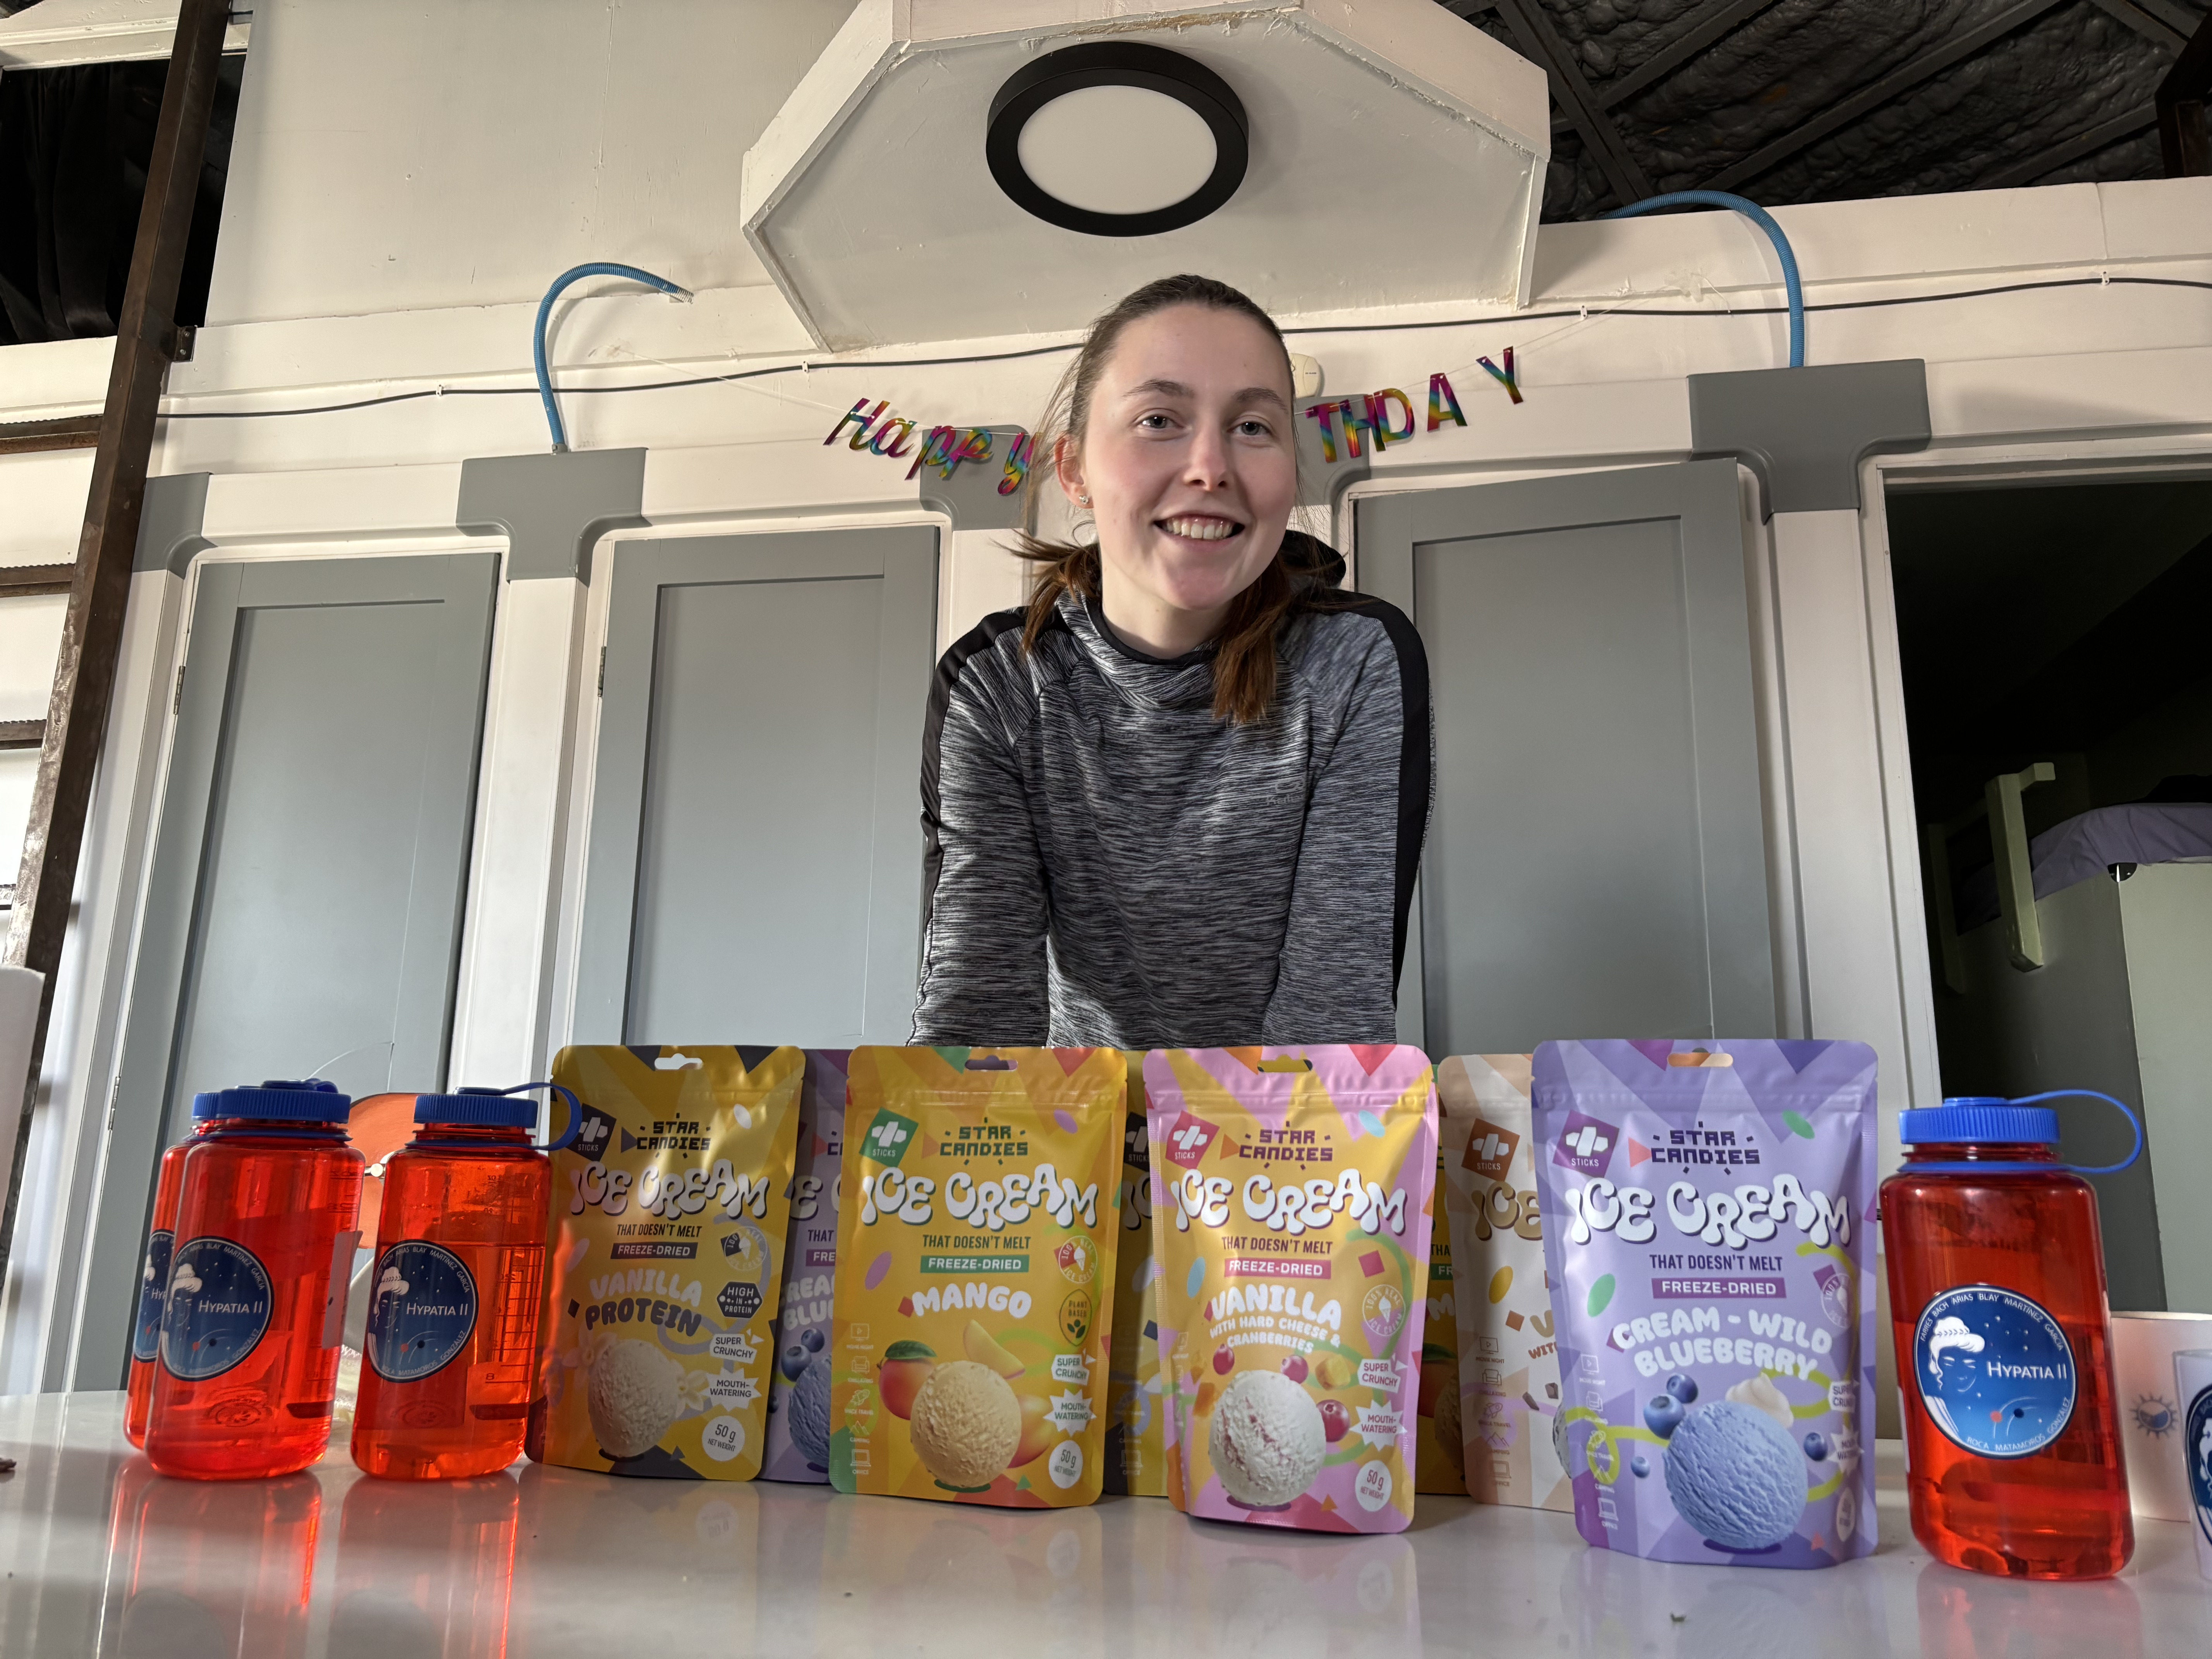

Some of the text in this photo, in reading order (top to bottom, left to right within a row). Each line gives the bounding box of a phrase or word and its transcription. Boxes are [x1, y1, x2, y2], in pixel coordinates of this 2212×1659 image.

[653, 1121, 699, 1134] STAR
[959, 1126, 1012, 1140] STAR
[637, 1137, 711, 1150] CANDIES
[1259, 1129, 1316, 1144] STAR
[1670, 1130, 1736, 1146] STAR
[872, 1148, 896, 1158] STICKS
[940, 1142, 1028, 1156] CANDIES
[1175, 1151, 1195, 1160] STICKS
[1239, 1145, 1333, 1161] CANDIES
[1651, 1147, 1760, 1164] CANDIES
[1477, 1162, 1501, 1171] STICKS
[1571, 1157, 1600, 1167] STICKS
[570, 1161, 632, 1216] ICE
[638, 1159, 770, 1220] CREAM
[861, 1166, 936, 1226] ICE
[945, 1163, 1099, 1231] CREAM
[1170, 1168, 1407, 1237] ICE CREAM
[1471, 1181, 1543, 1241] ICE
[1565, 1173, 1850, 1250] ICE CREAM
[617, 1223, 702, 1237] THAT DOESN'T MELT
[808, 1229, 834, 1242] THAT
[922, 1234, 1031, 1250] THAT DOESN'T MELT
[1222, 1236, 1333, 1255] THAT DOESN'T MELT
[396, 1247, 409, 1255] ARIAS
[618, 1245, 690, 1256] FREEZE-DRIED
[1431, 1243, 1450, 1256] THA
[929, 1258, 1022, 1270] FREEZE-DRIED
[1228, 1260, 1323, 1276] FREEZE-DRIED
[1650, 1254, 1783, 1271] THAT DOESN'T MELT
[589, 1268, 702, 1307] VANILLA
[727, 1287, 754, 1297] HIGH
[1662, 1281, 1777, 1295] FREEZE-DRIED
[199, 1300, 263, 1314] HYPATIA II
[912, 1282, 1032, 1319] MANGO
[1211, 1284, 1342, 1331] VANILLA
[1932, 1301, 1949, 1317] BACH
[1952, 1293, 1973, 1305] ARIAS
[1979, 1293, 1999, 1302] BLAY
[407, 1302, 468, 1316] HYPATIA II
[725, 1305, 752, 1314] PROTEIN
[585, 1297, 702, 1337] PROTEIN
[1209, 1316, 1341, 1348] WITH HARD CHEESE &
[1369, 1318, 1381, 1332] ICE
[1613, 1307, 1720, 1349] CREAM
[1748, 1310, 1833, 1354] WILD
[1227, 1331, 1314, 1353] CRANBERRIES
[713, 1346, 754, 1358] CRUNCHY
[1634, 1337, 1818, 1381] BLUEBERRY
[398, 1361, 438, 1375] MATAMOROS
[1057, 1357, 1080, 1367] SUPER
[1364, 1362, 1389, 1372] SUPER
[1055, 1368, 1087, 1379] CRUNCHY
[1987, 1361, 2067, 1379] HYPATIA II
[716, 1380, 750, 1388] MOUTH-
[1362, 1373, 1398, 1387] CRUNCHY
[710, 1388, 752, 1397] WATERING
[1061, 1402, 1086, 1411] MOUTH-
[1055, 1411, 1088, 1421] WATERING
[1368, 1415, 1396, 1424] MOUTH-
[715, 1424, 736, 1443] 50 g
[1361, 1423, 1397, 1434] WATERING
[1967, 1436, 1989, 1449] ROCA
[1995, 1433, 2045, 1451] MATAMOROS
[1061, 1449, 1076, 1468] 50 g
[1367, 1470, 1384, 1491] 50 g
